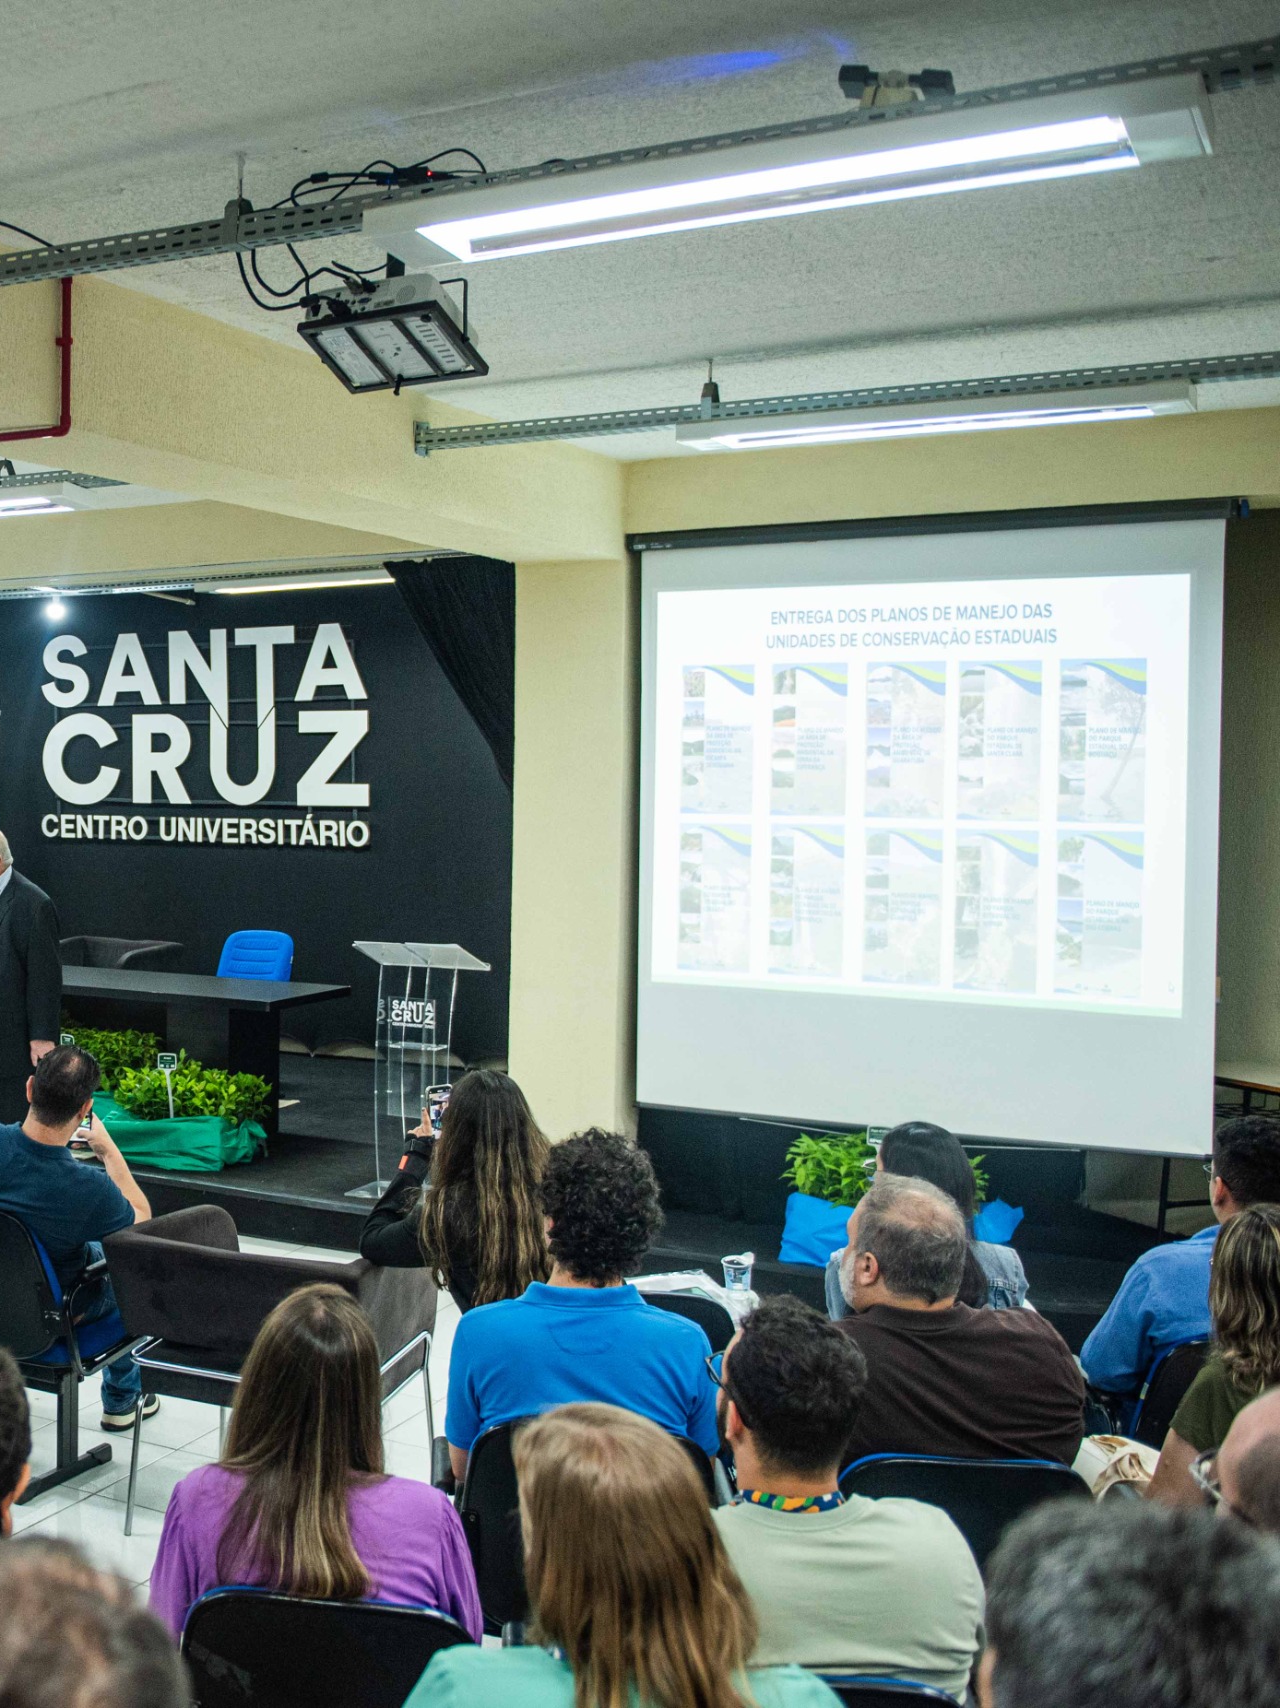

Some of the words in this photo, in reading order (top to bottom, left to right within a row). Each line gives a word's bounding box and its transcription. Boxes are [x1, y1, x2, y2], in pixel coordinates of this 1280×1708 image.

[771, 610, 834, 625] ENTREGA
[838, 609, 867, 623] DOS
[871, 607, 928, 622] PLANOS
[933, 606, 952, 621] DE
[956, 604, 1018, 620] MANEJO
[1022, 603, 1053, 618] DAS
[766, 633, 836, 649] UNIDADES
[840, 633, 858, 647] DE
[862, 627, 971, 649] CONSERVAÇÃO
[975, 628, 1057, 646] ESTADUAIS
[41, 622, 368, 722] SANTA
[41, 706, 370, 806] CRUZ
[41, 814, 149, 841] CENTRO
[159, 813, 370, 848] UNIVERSITÁRIO
[392, 999, 433, 1012] SANTA
[391, 1010, 435, 1024] CRUZ
